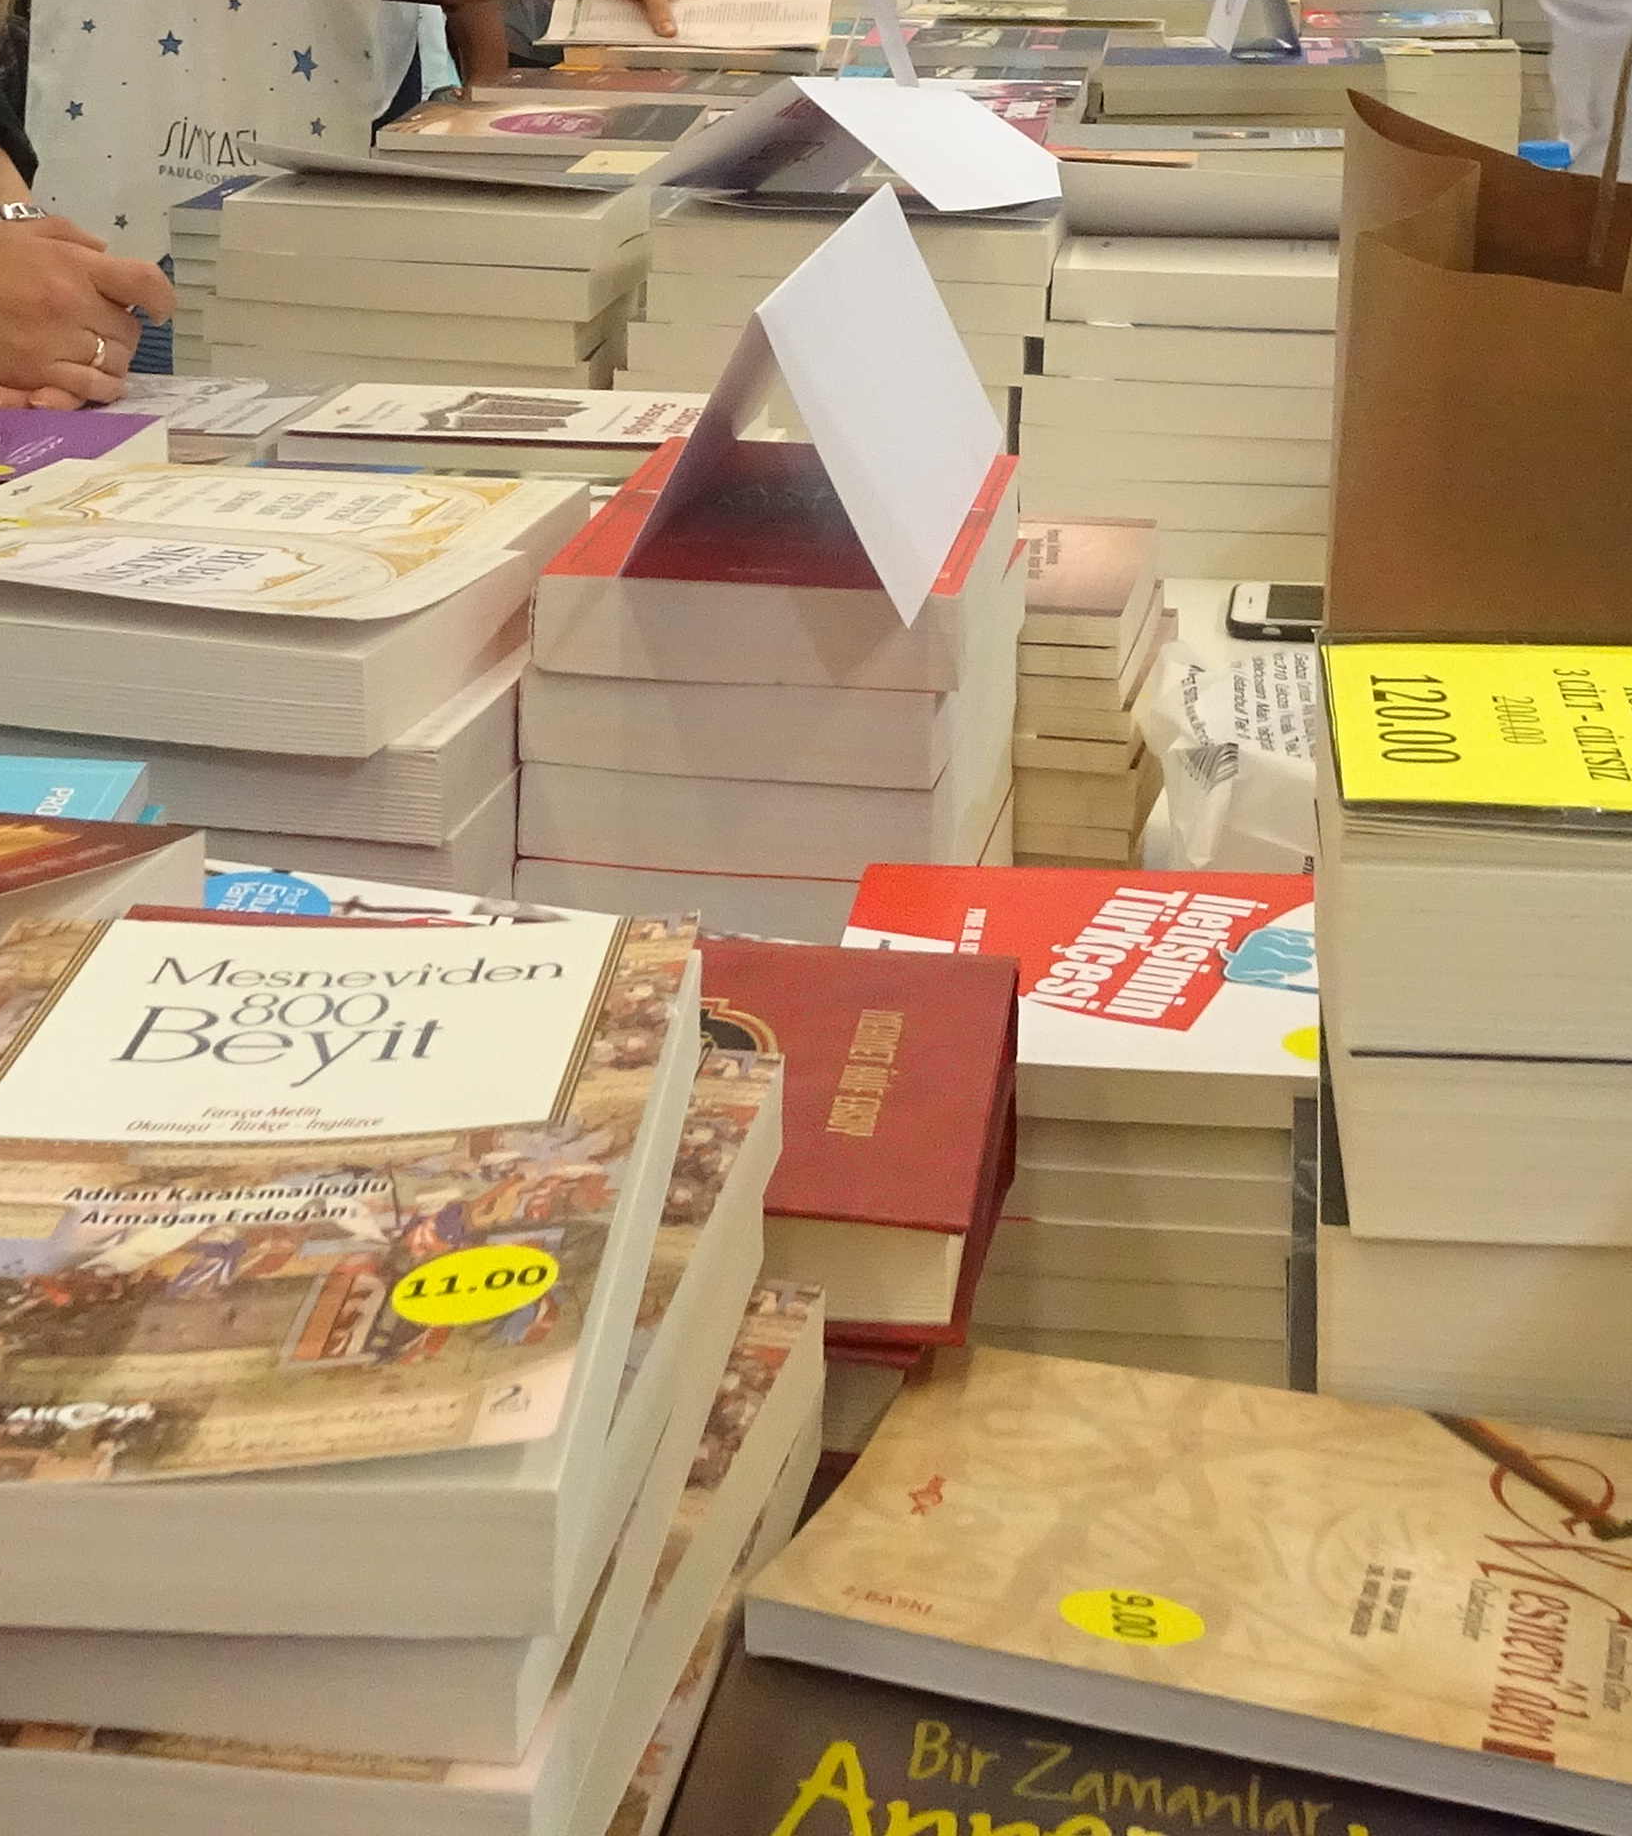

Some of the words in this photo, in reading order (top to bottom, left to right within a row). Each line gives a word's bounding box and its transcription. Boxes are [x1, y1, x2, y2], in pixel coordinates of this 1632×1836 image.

[159, 164, 203, 181] PAULO
[1553, 667, 1591, 679] 3
[1557, 678, 1607, 715] CİLT
[1369, 672, 1461, 765] 120.00
[1491, 694, 1548, 746] 200.00
[1572, 724, 1632, 783] CİLTSİZ
[1027, 886, 1189, 1011] Türkçesi
[1103, 893, 1270, 1020] İletişimin
[229, 992, 391, 1028] 800
[111, 1005, 444, 1089] Beyit
[65, 1184, 159, 1204] Adnan
[165, 1176, 389, 1205] Karaismailoğlu
[79, 1206, 218, 1228] Armağan
[401, 1264, 550, 1300] 11.00
[1111, 1591, 1157, 1642] 9.00
[908, 1718, 999, 1789] Bir
[1012, 1739, 1334, 1835] Zamanlar
